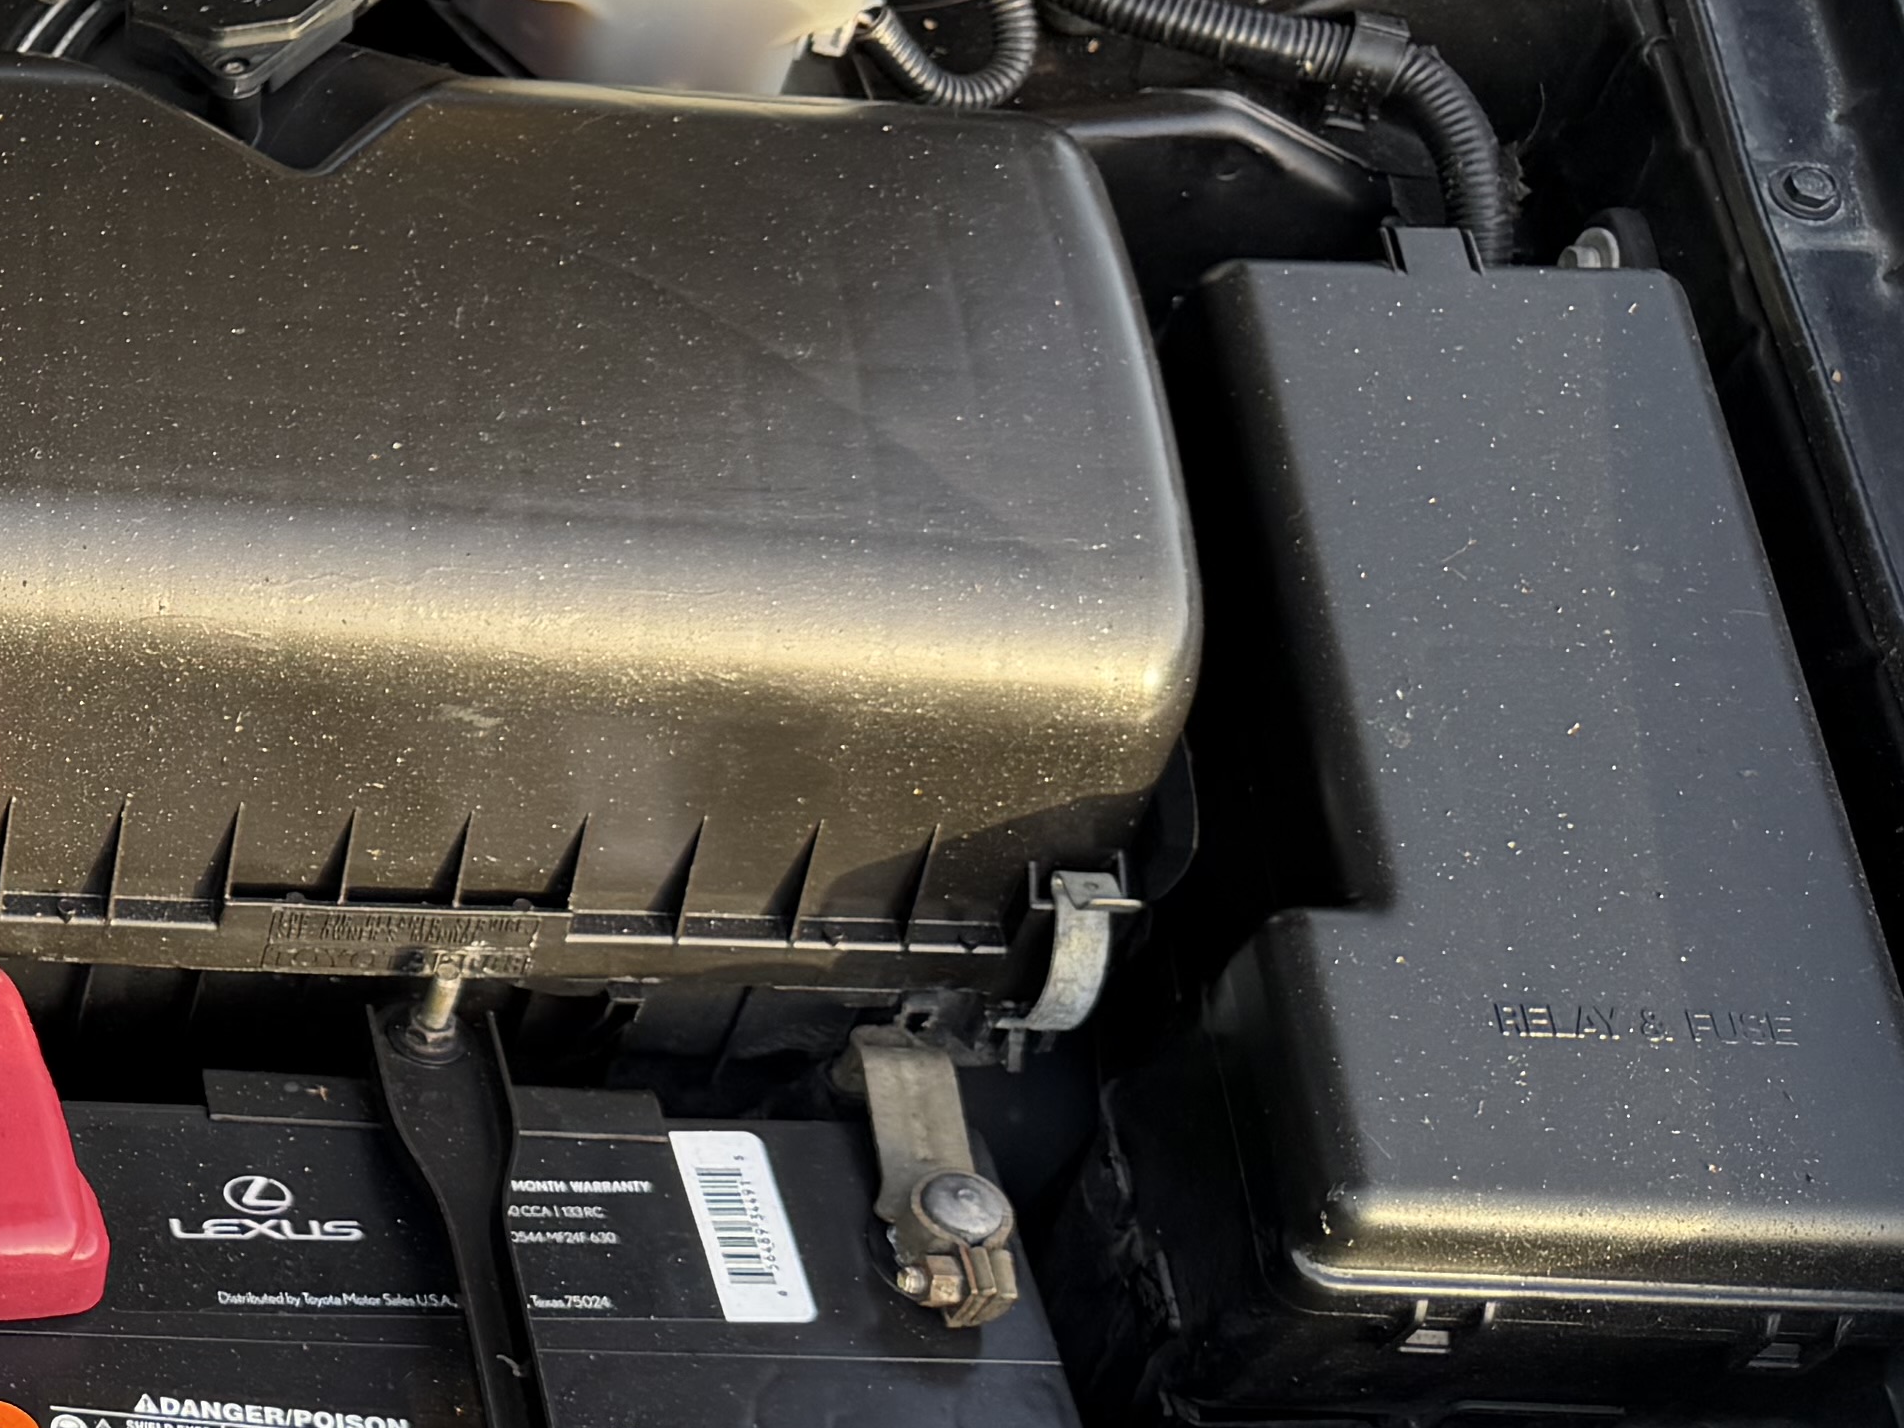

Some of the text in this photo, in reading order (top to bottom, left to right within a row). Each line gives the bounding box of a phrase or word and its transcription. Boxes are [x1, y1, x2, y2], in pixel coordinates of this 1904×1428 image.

[1494, 1002, 1798, 1046] RELAY & FUSE
[511, 1180, 652, 1194] MONTH WARRANTY
[169, 1218, 367, 1241] LEXUS
[217, 1290, 415, 1307] Distributed by Toyota Motor Sales
[566, 1295, 612, 1309] 75024
